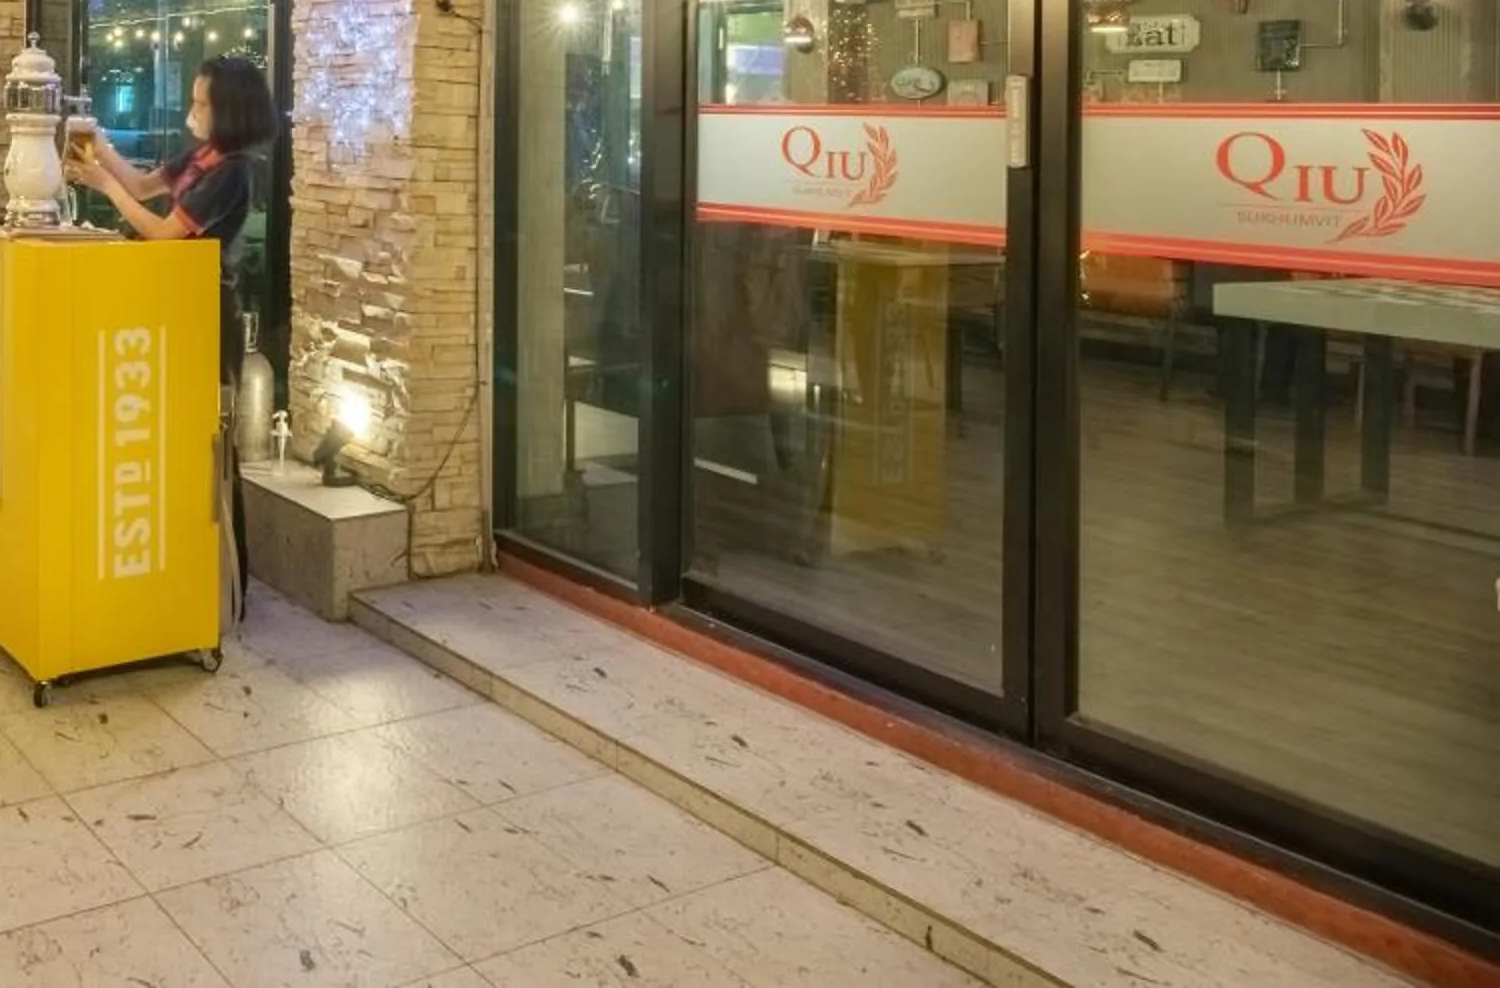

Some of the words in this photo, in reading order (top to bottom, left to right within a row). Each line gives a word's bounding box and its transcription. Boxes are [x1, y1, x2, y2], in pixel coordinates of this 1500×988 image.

[781, 125, 867, 180] QIU
[1216, 131, 1369, 204] QIU
[114, 326, 151, 446] 1933
[114, 461, 151, 578] ESTD
